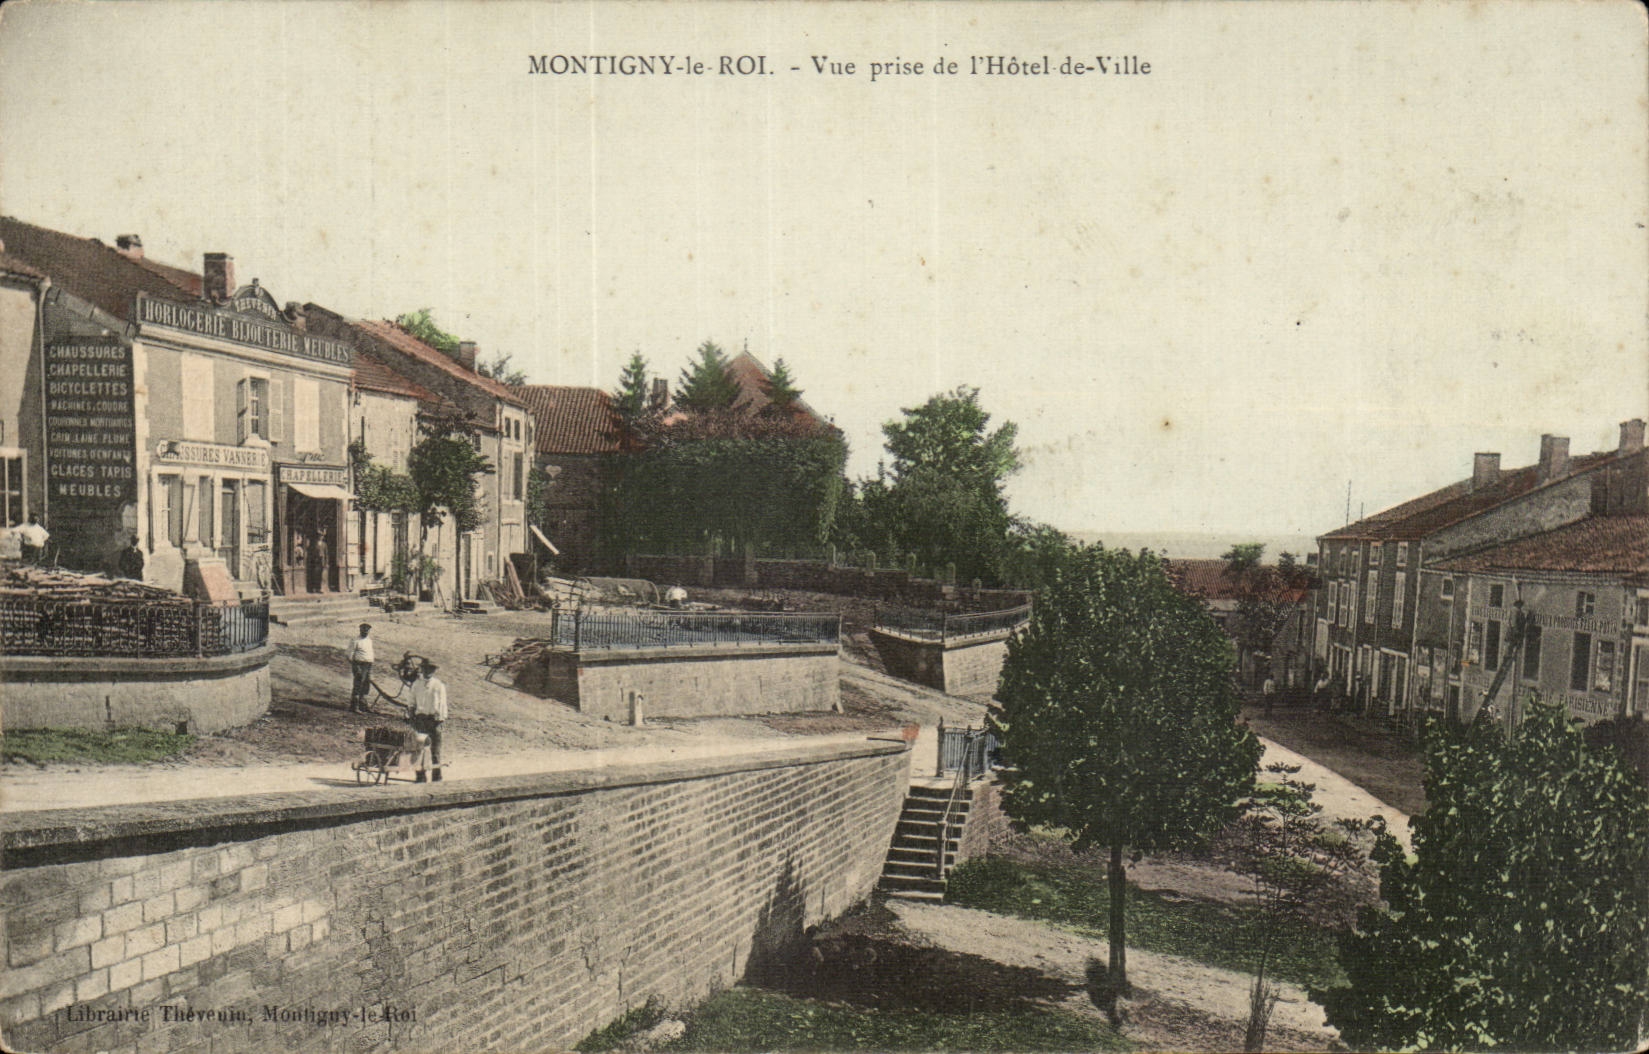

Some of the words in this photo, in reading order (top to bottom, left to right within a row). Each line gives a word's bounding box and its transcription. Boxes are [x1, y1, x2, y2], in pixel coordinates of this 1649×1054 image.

[145, 300, 226, 336] HORLOGERIE
[232, 319, 299, 352] BIJOUTERIE
[303, 336, 350, 364] MEUBLES
[49, 345, 125, 359] CHAUSSURES
[49, 363, 127, 377] CHAPELLERIE
[49, 382, 128, 396] BICYCLETTES
[51, 464, 95, 478] GLACES
[100, 465, 132, 479] TAPIS
[280, 469, 343, 483] CHAPELLERIE
[59, 483, 121, 498] MEUBLES
